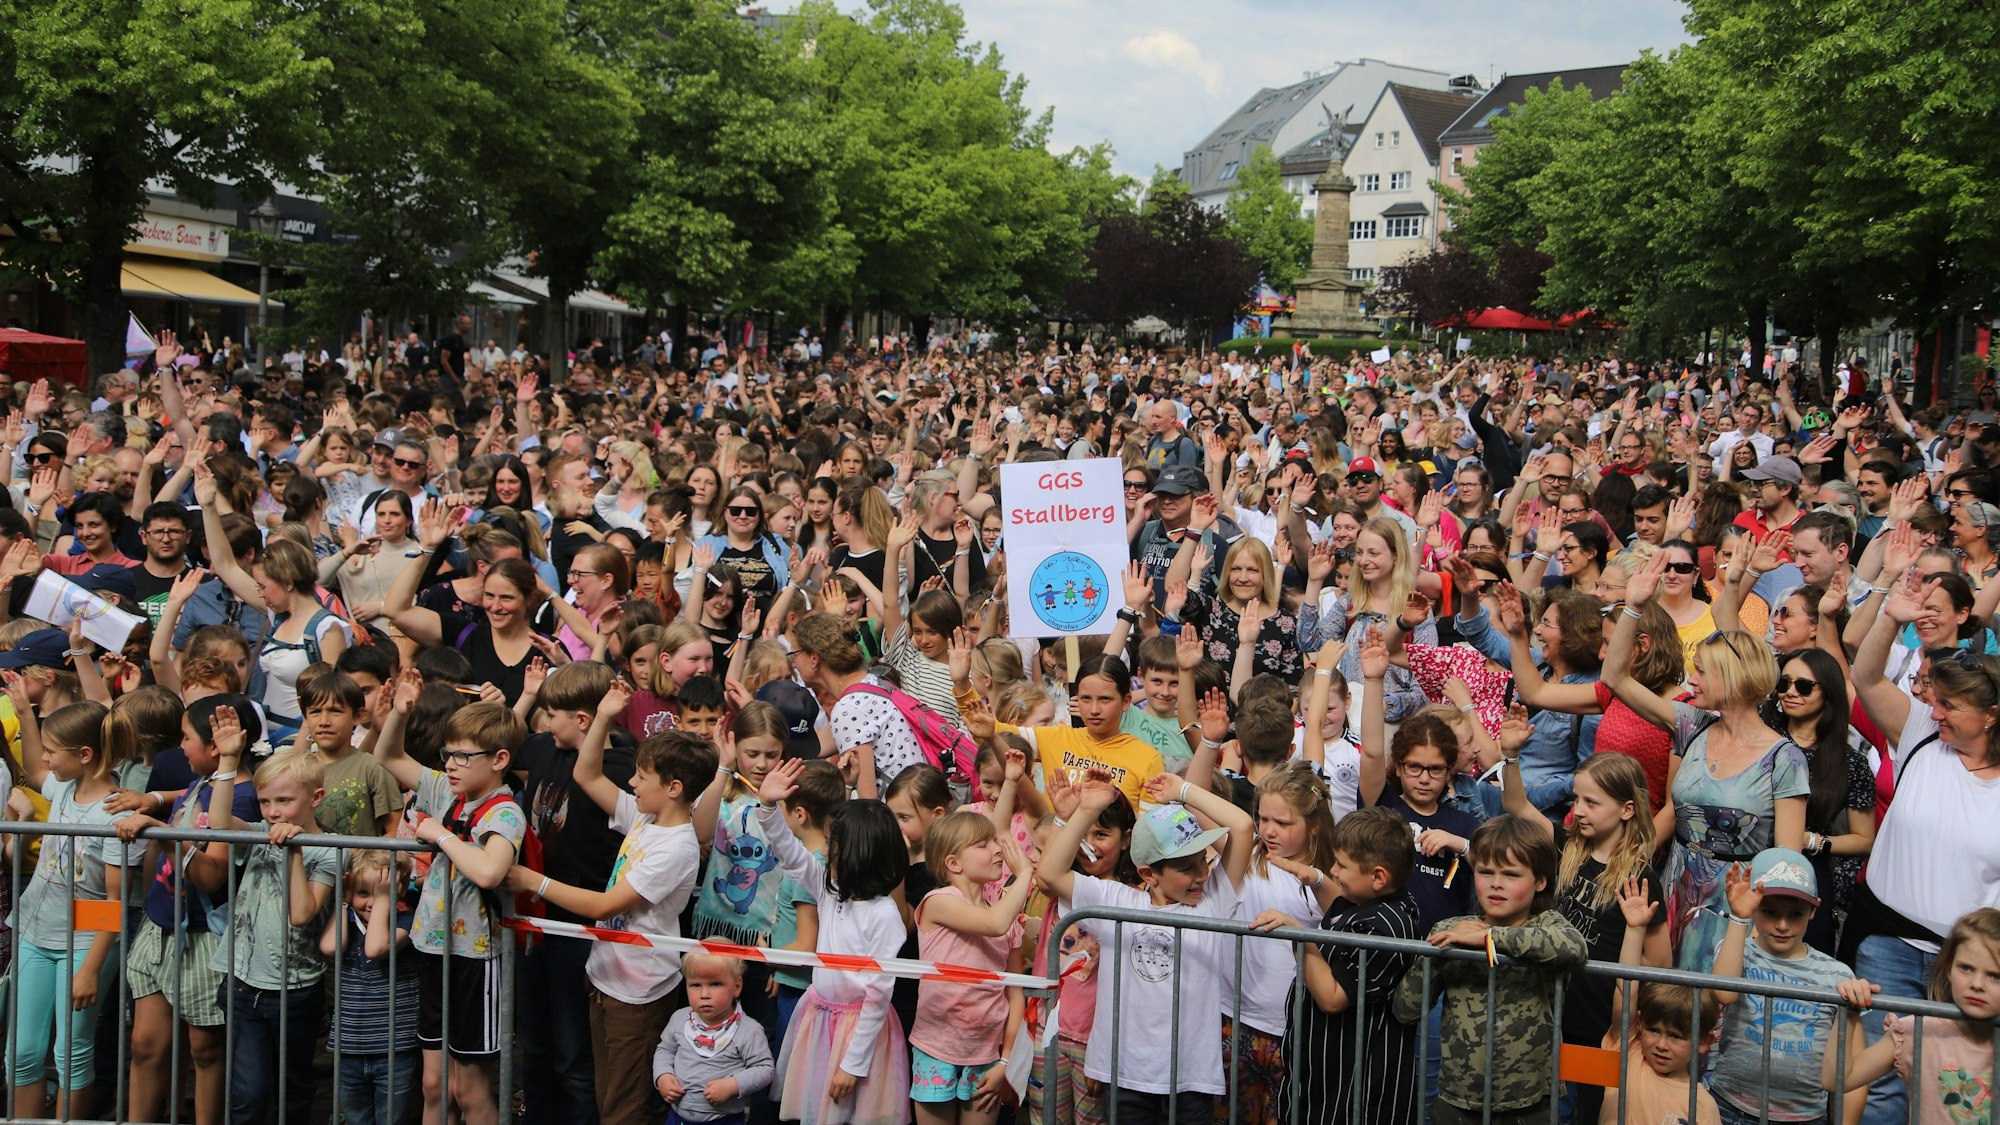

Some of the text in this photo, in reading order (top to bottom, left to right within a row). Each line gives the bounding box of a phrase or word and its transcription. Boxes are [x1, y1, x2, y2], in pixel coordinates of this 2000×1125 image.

[176, 224, 202, 246] Bauer
[1038, 471, 1084, 491] GGS
[1011, 504, 1115, 525] Stallberg
[1110, 766, 1127, 784] ST
[1420, 864, 1445, 877] COAST
[1772, 1038, 1813, 1054] BLUE BAY
